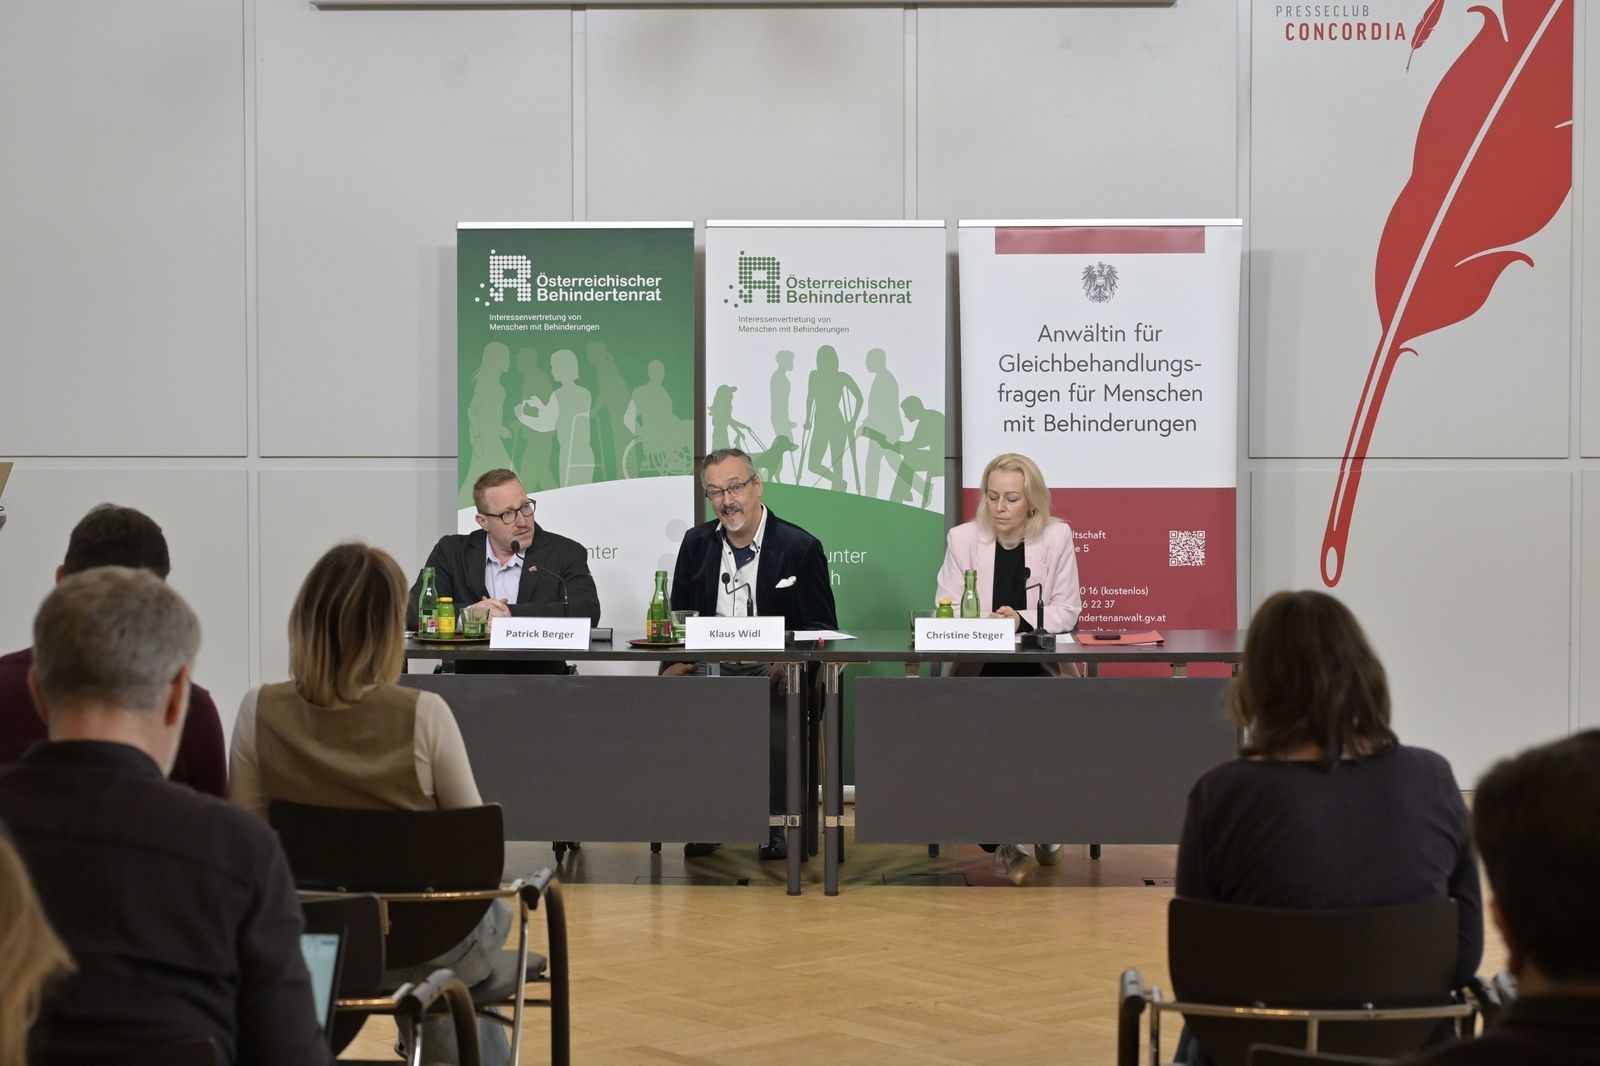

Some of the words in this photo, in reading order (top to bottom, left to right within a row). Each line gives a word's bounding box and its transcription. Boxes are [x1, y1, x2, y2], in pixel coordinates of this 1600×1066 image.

[1275, 5, 1369, 17] PRESSECLUB
[1285, 22, 1406, 41] CONCORDIA
[536, 272, 662, 287] Österreichischer
[786, 274, 913, 289] Österreichischer
[536, 288, 662, 302] Behindertenrat
[786, 290, 912, 304] Behindertenrat
[489, 313, 566, 322] Interessenvertretung
[738, 315, 816, 324] Interessenvertretung
[489, 323, 528, 331] Menschen
[530, 323, 542, 331] mit
[543, 323, 600, 332] Behinderungen
[738, 325, 777, 333] Menschen
[779, 325, 791, 333] mit
[793, 325, 850, 335] Behinderungen
[1037, 322, 1126, 342] Anwältin
[1134, 322, 1163, 342] für
[998, 352, 1202, 378] Gleichbehandlungs-
[997, 383, 1060, 408] fragen
[1068, 383, 1096, 402] für
[1104, 382, 1203, 402] Menschen
[1003, 414, 1035, 432] mit
[1044, 412, 1197, 437] Behinderungen
[1072, 530, 1106, 539] ltschaft
[585, 545, 618, 559] nter
[1083, 544, 1090, 553] 5
[1080, 586, 1086, 595] 0
[1088, 586, 1098, 595] 16
[1101, 586, 1149, 596] (kostenlos)
[1081, 600, 1088, 609] 6
[1091, 600, 1102, 609] 22
[1104, 600, 1115, 609] 37
[1078, 613, 1166, 624] ndertenanwalt.gv.at
[506, 629, 540, 638] Patrick
[542, 630, 575, 640] Berger
[709, 629, 736, 638] Klaus
[738, 629, 761, 638] Widl
[926, 631, 970, 640] Christine
[972, 631, 1004, 641] Steger
